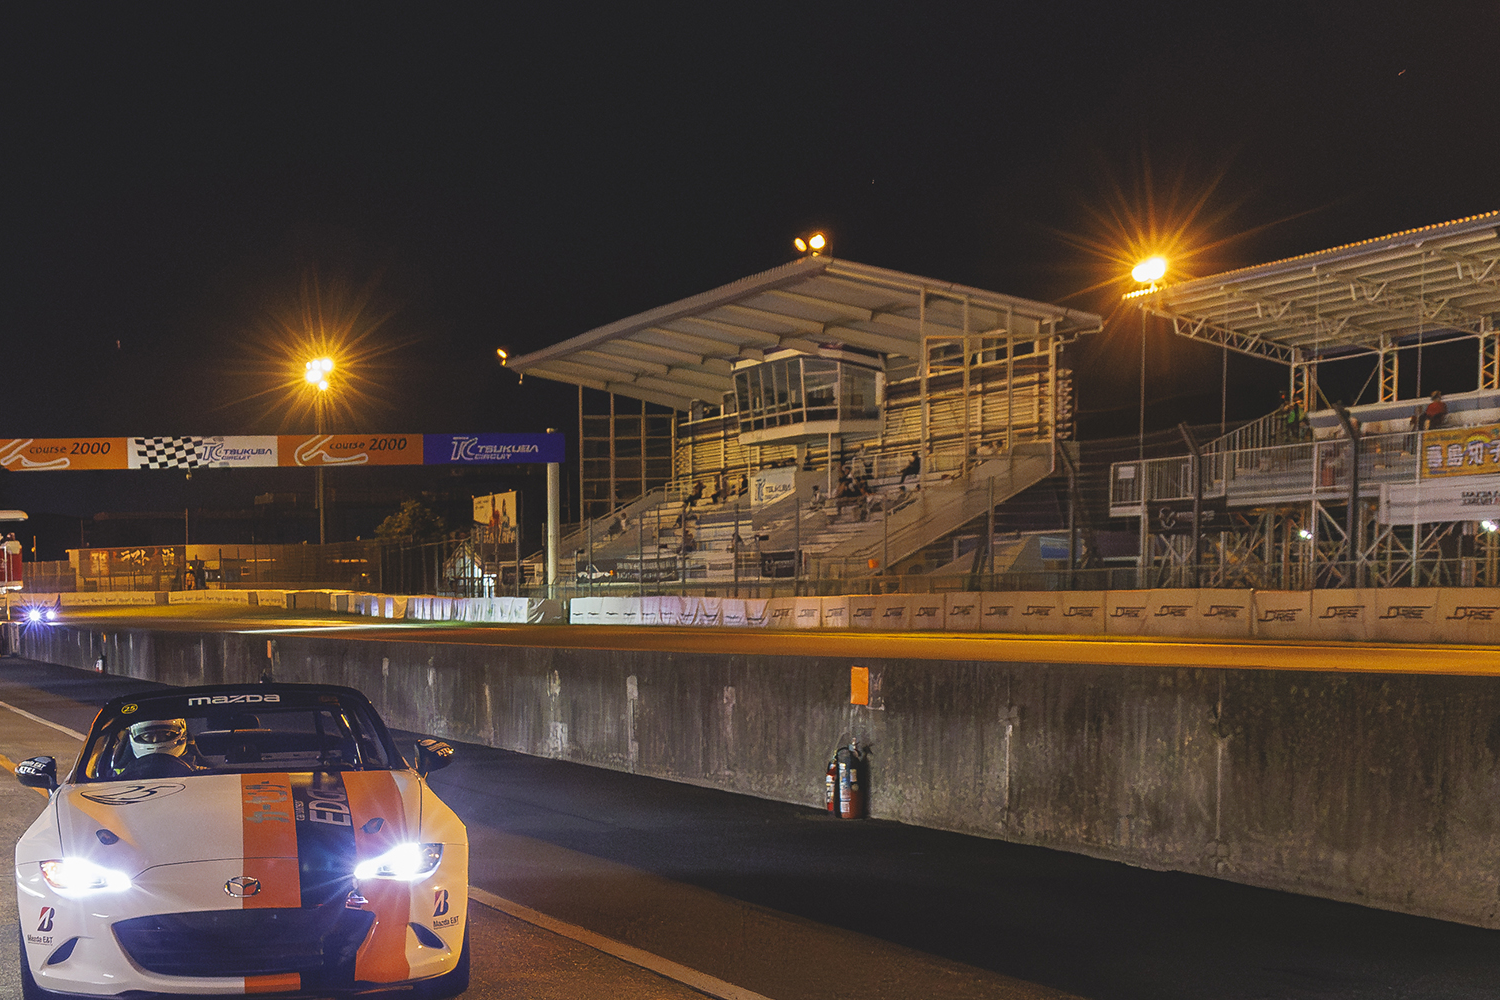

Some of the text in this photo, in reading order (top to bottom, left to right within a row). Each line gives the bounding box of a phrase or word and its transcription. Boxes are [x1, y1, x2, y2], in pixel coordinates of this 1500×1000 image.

[29, 441, 111, 455] course 2000
[329, 437, 408, 451] course 2000
[477, 444, 539, 453] TSUKUBA
[123, 704, 137, 713] 25
[90, 785, 177, 801] 25
